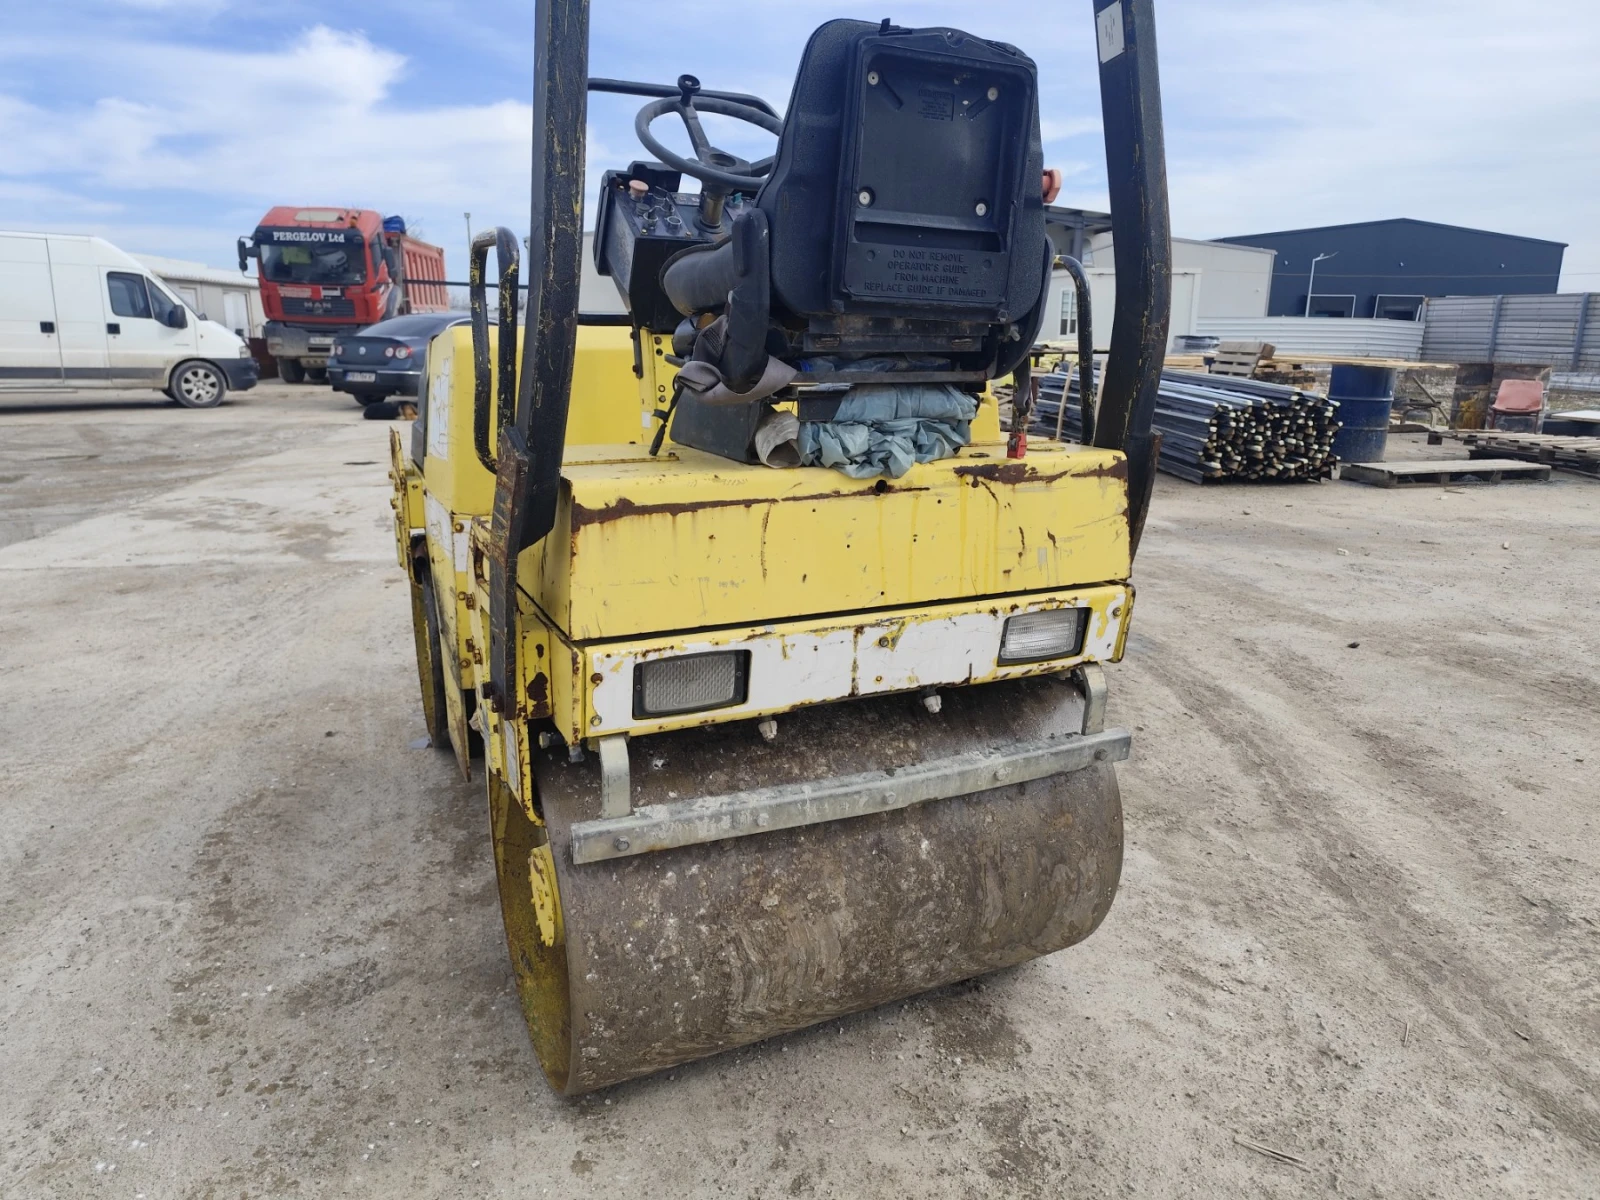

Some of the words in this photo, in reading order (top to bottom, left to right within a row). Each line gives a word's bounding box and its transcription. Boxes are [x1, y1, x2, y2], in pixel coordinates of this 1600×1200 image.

[272, 231, 326, 242] PERGELOV
[328, 233, 345, 243] Ltd
[893, 248, 906, 259] DO
[908, 250, 927, 260] NOT
[929, 252, 965, 263] REMOVE
[887, 260, 939, 272] OPERATOR'S
[942, 264, 969, 274] GUIDE
[894, 272, 919, 282] FROM
[922, 274, 960, 285] MACHINE
[864, 281, 903, 293] REPLACE
[907, 284, 934, 295] GUIDE
[936, 286, 946, 296] IF
[948, 286, 987, 298] DAMAGED
